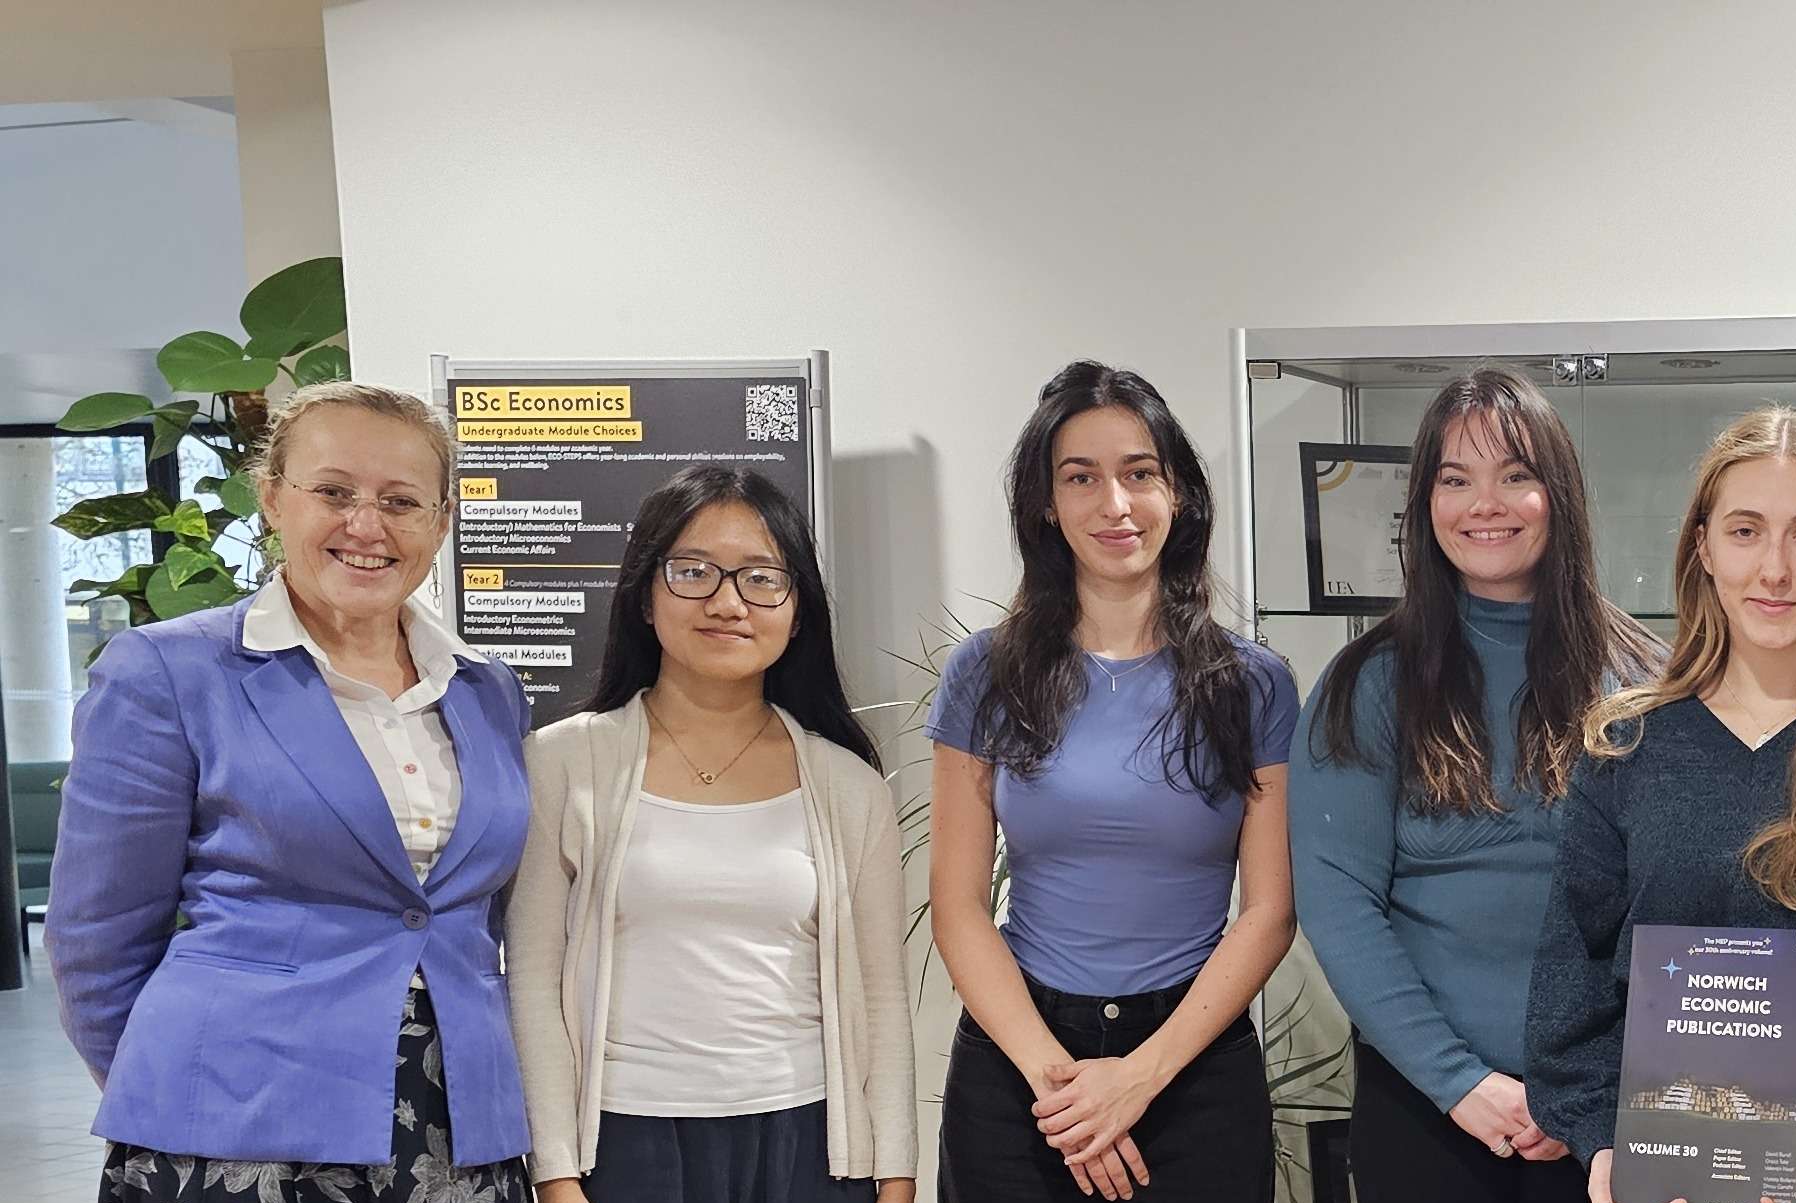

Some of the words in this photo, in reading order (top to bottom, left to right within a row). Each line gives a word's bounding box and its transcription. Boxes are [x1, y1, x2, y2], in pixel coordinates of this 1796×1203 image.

[462, 391, 501, 411] BSc
[509, 391, 625, 411] Economics
[463, 426, 545, 438] Undergraduate
[549, 425, 590, 436] Module
[593, 425, 637, 436] Choices
[463, 484, 486, 495] Year
[489, 485, 493, 494] 1
[464, 504, 528, 518] Compulsory
[533, 504, 579, 515] Modules
[459, 522, 513, 532] (Introductory)
[515, 522, 563, 532] Mathematics
[564, 522, 576, 532] for
[577, 522, 622, 532] Economists
[459, 533, 508, 544] Introductory
[509, 534, 572, 543] Microeconomics
[461, 545, 491, 554] Current
[466, 574, 490, 585] Year
[493, 574, 499, 585] 2
[468, 595, 532, 609] Compulsory
[535, 596, 581, 606] Modules
[464, 614, 511, 625] Introductory
[512, 615, 564, 624] Econometrics
[464, 626, 512, 635] Intermediate
[513, 627, 576, 636] Microeconomics
[480, 649, 517, 660] tional
[521, 650, 567, 660] Modules
[522, 684, 560, 693] conomics
[1688, 974, 1768, 991] NORWICH
[1681, 997, 1772, 1015] ECONOMIC
[1666, 1020, 1782, 1039] PUBLICATIONS
[1629, 1142, 1680, 1156] VOLUME
[1683, 1146, 1698, 1157] 30
